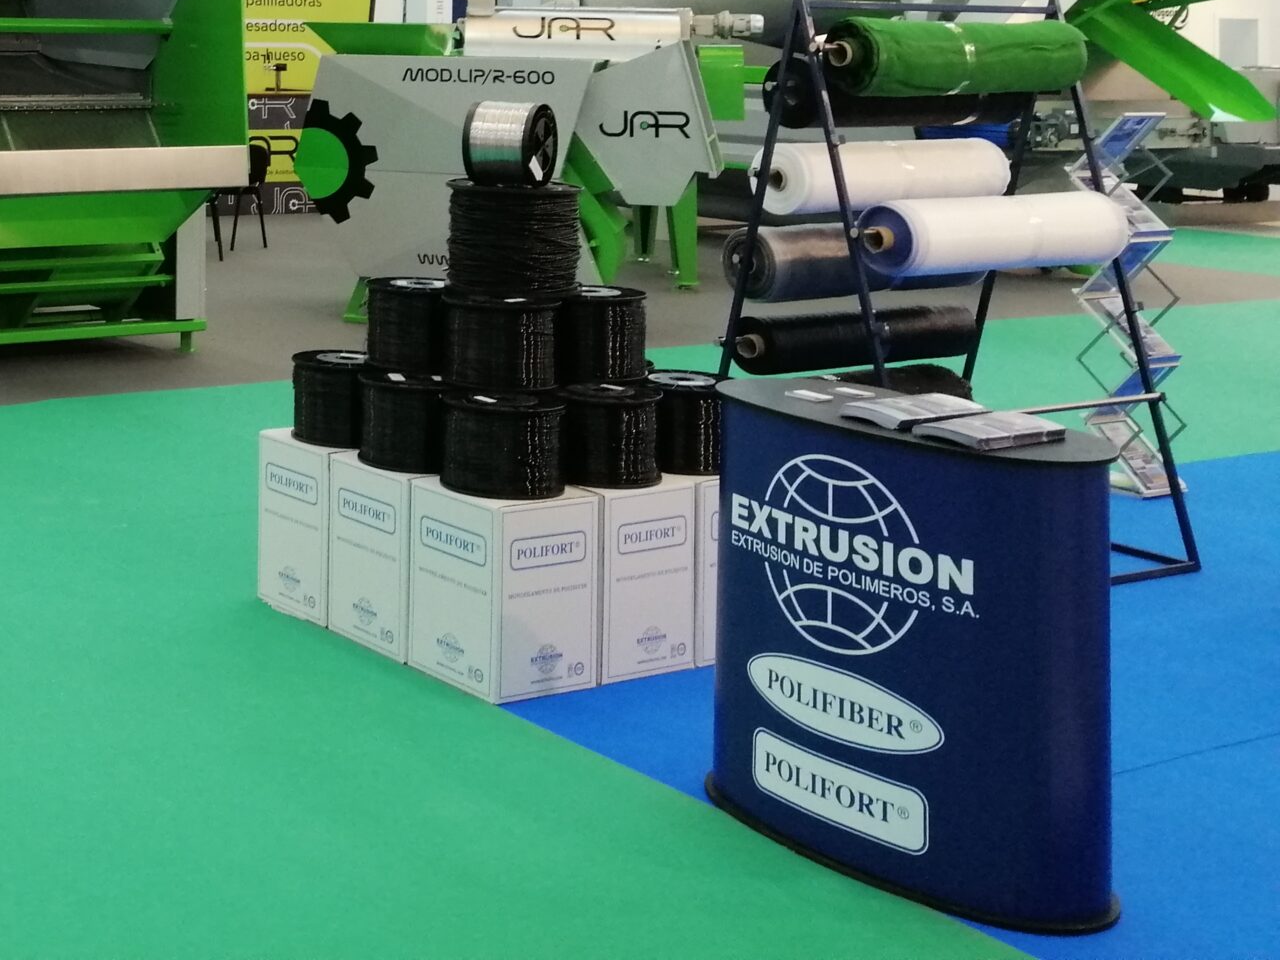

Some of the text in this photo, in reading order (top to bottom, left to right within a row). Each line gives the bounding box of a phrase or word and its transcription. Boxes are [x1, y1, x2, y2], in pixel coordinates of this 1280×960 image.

[245, 19, 307, 33] esadoras
[512, 16, 617, 41] JAR
[598, 109, 691, 139] JAR
[731, 492, 975, 596] EXTRUSION
[731, 529, 981, 619] EXTRUSION DE POLIMEROS, S.A.
